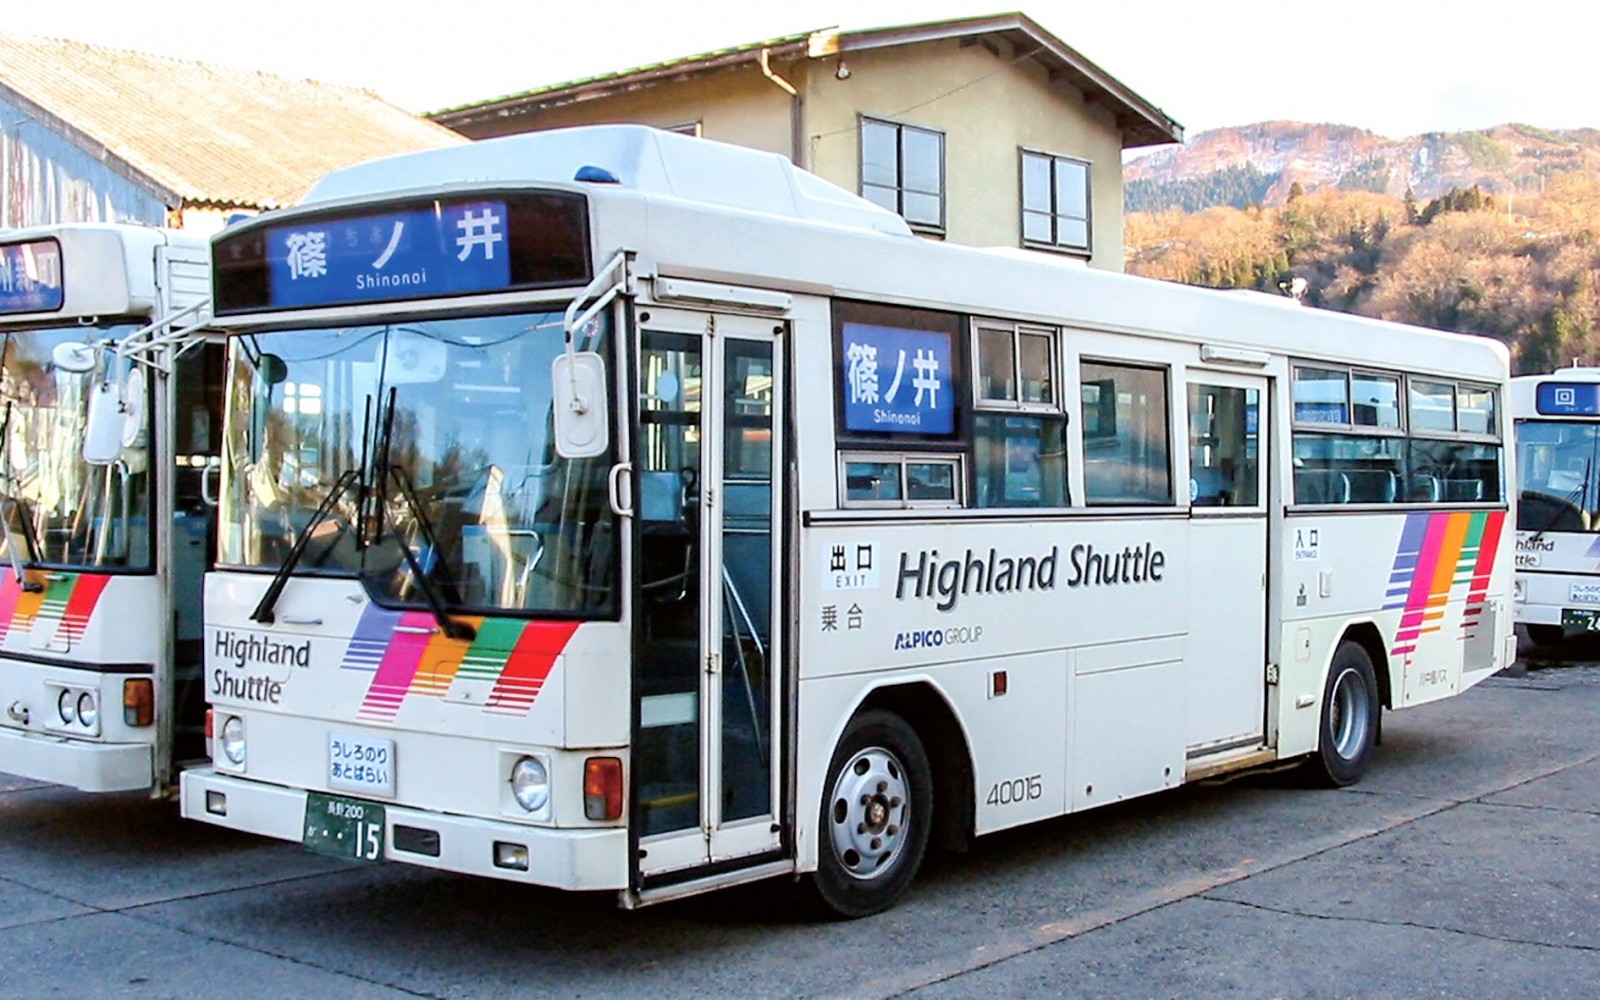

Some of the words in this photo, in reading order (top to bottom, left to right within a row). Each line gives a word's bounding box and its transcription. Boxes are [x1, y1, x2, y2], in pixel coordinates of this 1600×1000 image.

[286, 208, 502, 280] 篠ノ井
[356, 268, 427, 290] Shinonoi
[847, 342, 940, 409] 篠ノ井
[874, 409, 921, 425] Shinonoi
[1295, 529, 1318, 548] 入口
[830, 544, 872, 572] 出口
[836, 575, 866, 588] EXIT
[895, 545, 1058, 612] Highland
[1067, 542, 1166, 587] Shuttle
[821, 603, 863, 632] 乗合
[215, 630, 310, 668] Highland
[894, 629, 943, 650] ALPICO
[944, 625, 983, 646] GROUP
[213, 668, 281, 704] Shuttle
[332, 740, 387, 764] うしろのり
[332, 762, 388, 784] あとばらい
[986, 774, 1042, 806] 40015
